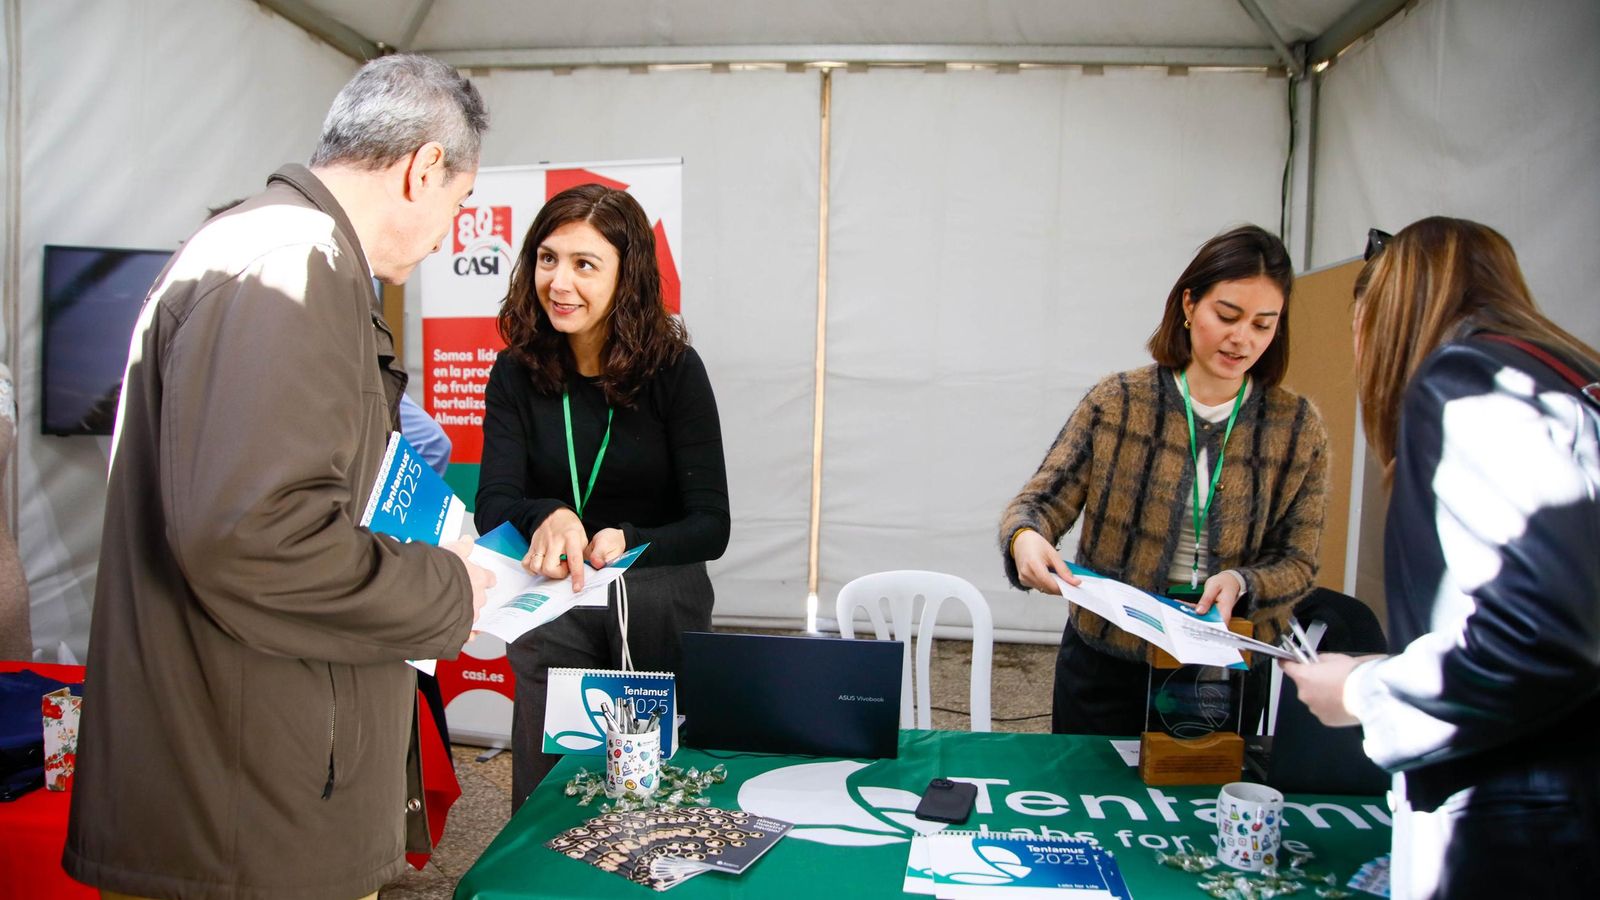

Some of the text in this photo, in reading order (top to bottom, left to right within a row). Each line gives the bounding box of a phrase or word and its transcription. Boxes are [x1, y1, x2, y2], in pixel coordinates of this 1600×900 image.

[453, 256, 499, 276] CASI
[433, 348, 473, 362] Somos
[433, 364, 493, 380] en la prod
[433, 380, 449, 393] de
[434, 411, 483, 426] Almería
[381, 452, 410, 513] Tentamus
[393, 459, 422, 525] 2025
[462, 668, 505, 683] casi.es
[623, 685, 668, 697] Tentamus
[1114, 829, 1190, 850] for
[1026, 845, 1085, 854] Tentamus
[1032, 853, 1089, 865] 2025
